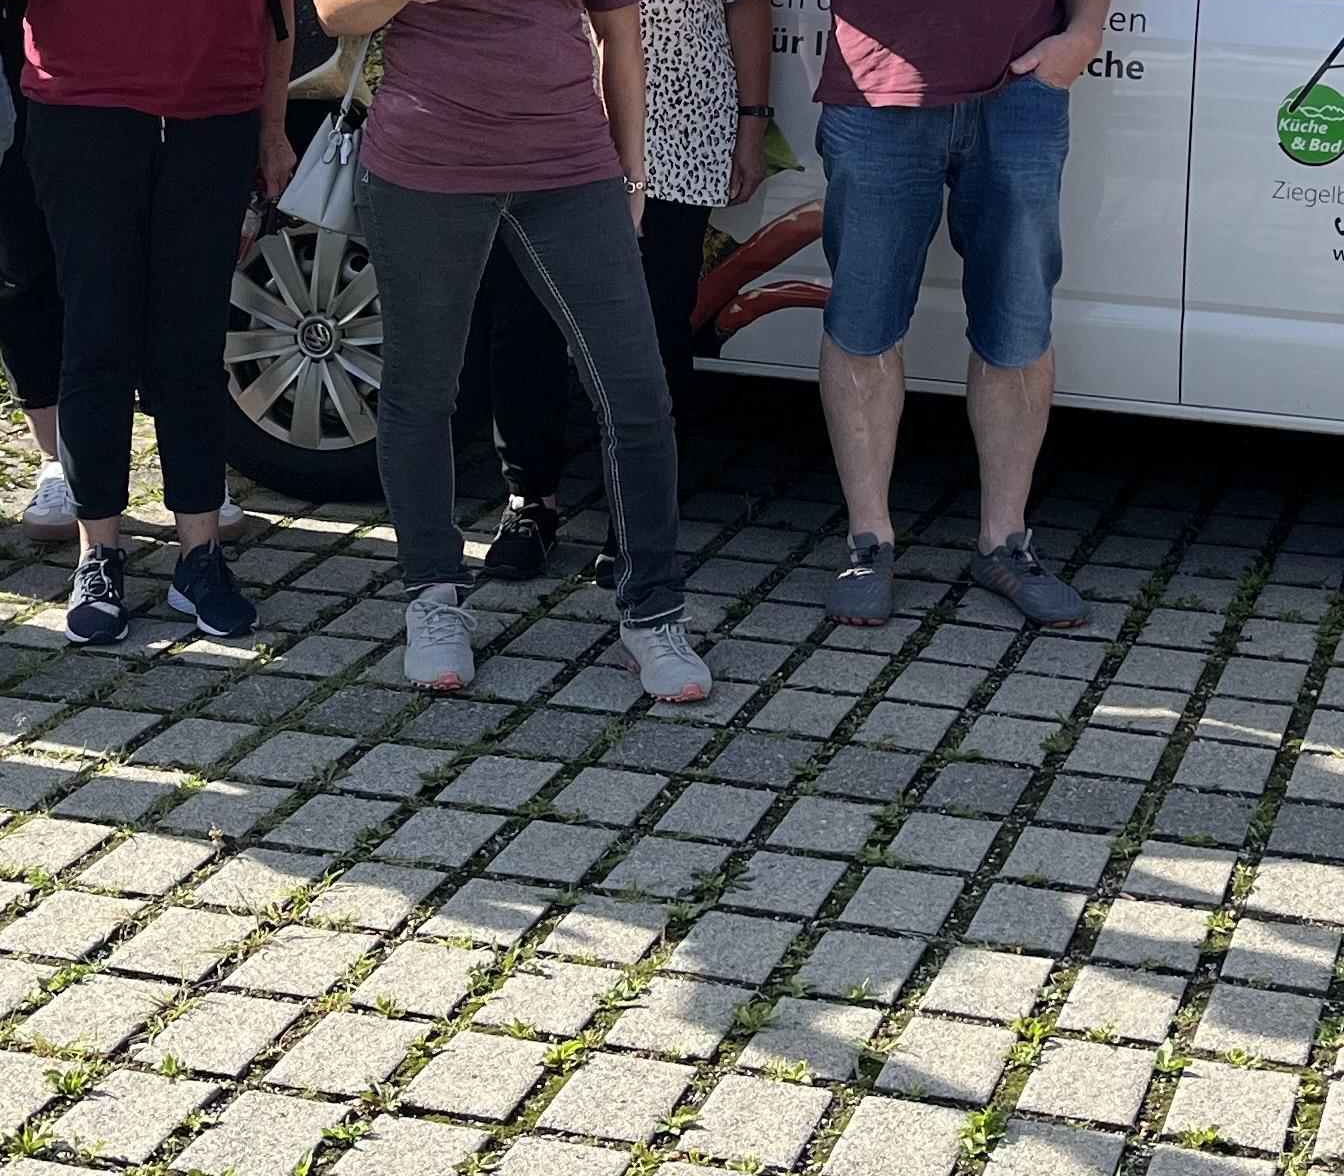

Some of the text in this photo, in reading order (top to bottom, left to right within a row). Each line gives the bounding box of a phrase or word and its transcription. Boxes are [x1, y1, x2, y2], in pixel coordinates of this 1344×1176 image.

[1278, 117, 1329, 135] Küche
[1290, 136, 1343, 153] & Bad
